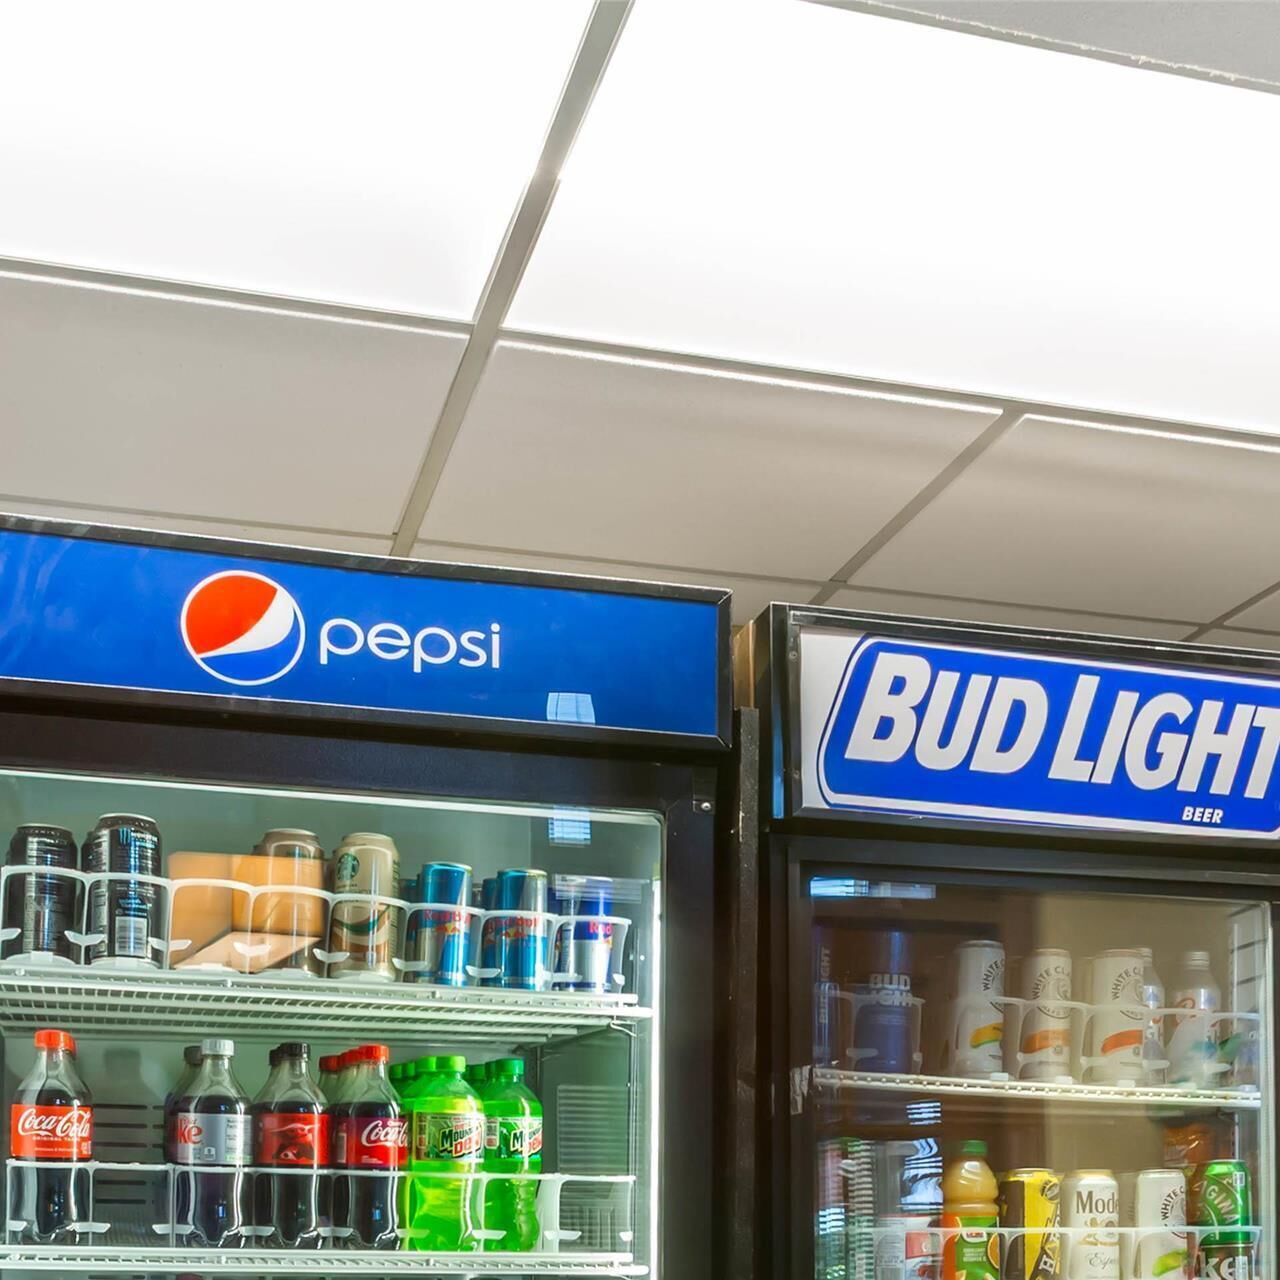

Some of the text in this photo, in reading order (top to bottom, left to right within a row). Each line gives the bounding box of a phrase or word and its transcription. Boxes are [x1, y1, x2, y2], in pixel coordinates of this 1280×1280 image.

[320, 617, 500, 673] pepsi
[844, 651, 1049, 775] BUD
[1181, 806, 1224, 824] BEER
[868, 973, 911, 990] BUD
[981, 959, 1001, 992] WHITE
[1031, 967, 1051, 1000] WHITE
[1111, 967, 1132, 1001] WHITE
[18, 1107, 91, 1138] Coca-Cola
[1075, 1190, 1119, 1214] Mod
[1160, 1189, 1182, 1221] WHITE
